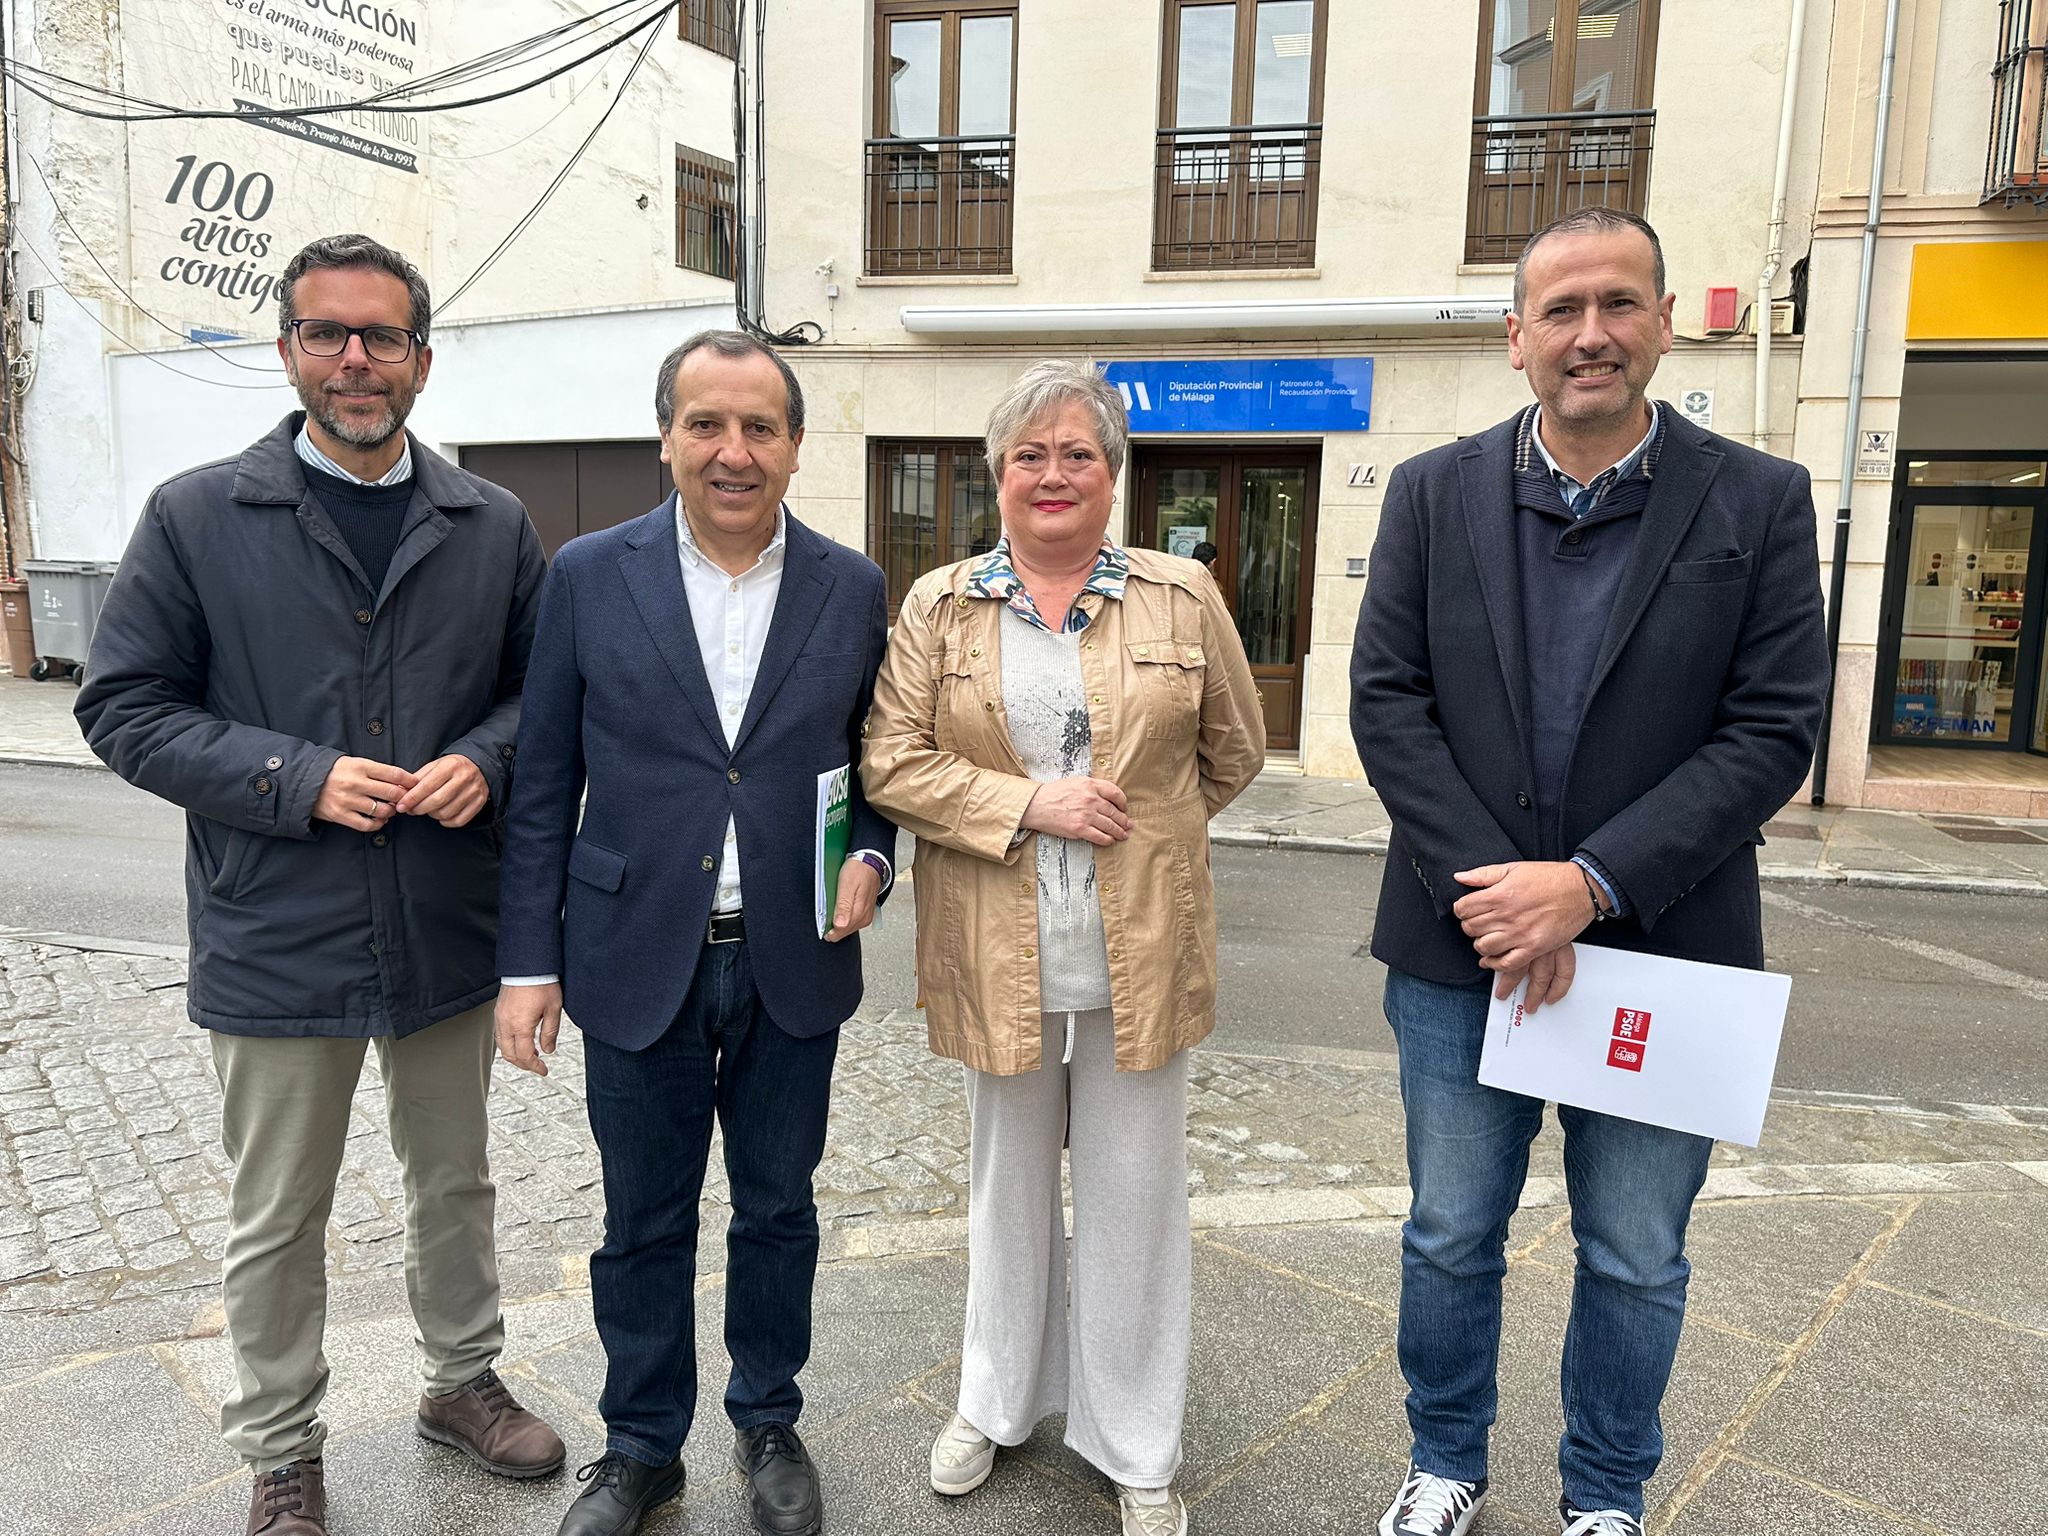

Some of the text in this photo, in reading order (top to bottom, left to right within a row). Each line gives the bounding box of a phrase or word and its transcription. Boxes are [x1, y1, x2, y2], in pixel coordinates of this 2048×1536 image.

[227, 22, 273, 54] que
[280, 41, 365, 86] puedes
[248, 0, 265, 16] el
[266, 8, 309, 36] arma
[312, 26, 346, 48] más
[344, 38, 414, 75] poderosa
[231, 56, 272, 98] PARA
[371, 105, 418, 146] MUNDO
[309, 125, 340, 144] Premio
[340, 135, 362, 151] Nobel
[361, 143, 372, 154] de
[372, 145, 380, 158] la
[380, 147, 394, 161] Paz
[394, 152, 414, 167] 1993
[165, 155, 274, 222] 100
[180, 215, 272, 258] años
[1168, 392, 1215, 403] de Málaga
[1169, 380, 1263, 391] Diputación Provincial
[1280, 388, 1358, 396] Recaudación Provincial
[1350, 465, 1374, 484] 14
[1620, 1010, 1635, 1037] PSOE
